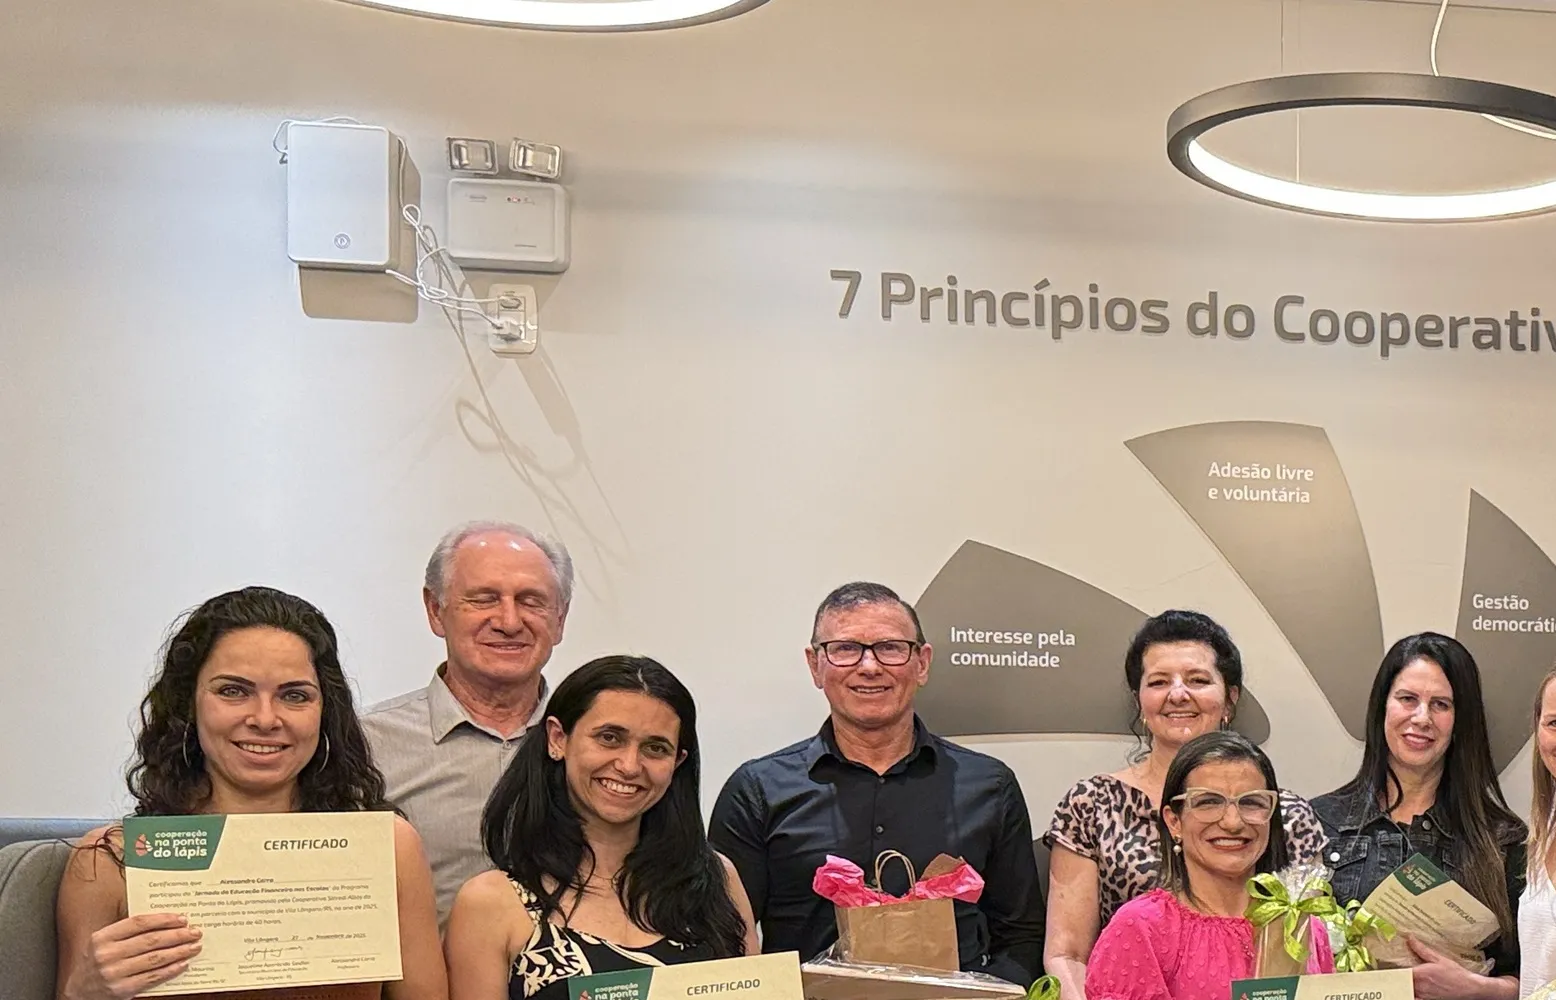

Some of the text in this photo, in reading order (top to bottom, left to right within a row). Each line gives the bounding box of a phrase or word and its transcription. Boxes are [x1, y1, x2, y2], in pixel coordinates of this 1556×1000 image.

[830, 269, 862, 318] 7
[880, 272, 1170, 341] Princípios
[1187, 291, 1255, 338] do
[1208, 462, 1314, 480] Adesão livre
[1208, 485, 1310, 503] e voluntária
[1472, 594, 1529, 610] Gestão
[951, 626, 1075, 649] Interesse pela
[951, 651, 1060, 667] comunidade
[154, 829, 207, 839] cooperação
[154, 837, 207, 848] na ponta
[263, 838, 348, 850] CERTIFICADO
[152, 845, 207, 859] do lápis
[1444, 899, 1476, 924] CERTIFICADO
[595, 989, 638, 1000] na ponta
[687, 978, 760, 996] CERTIFICADO
